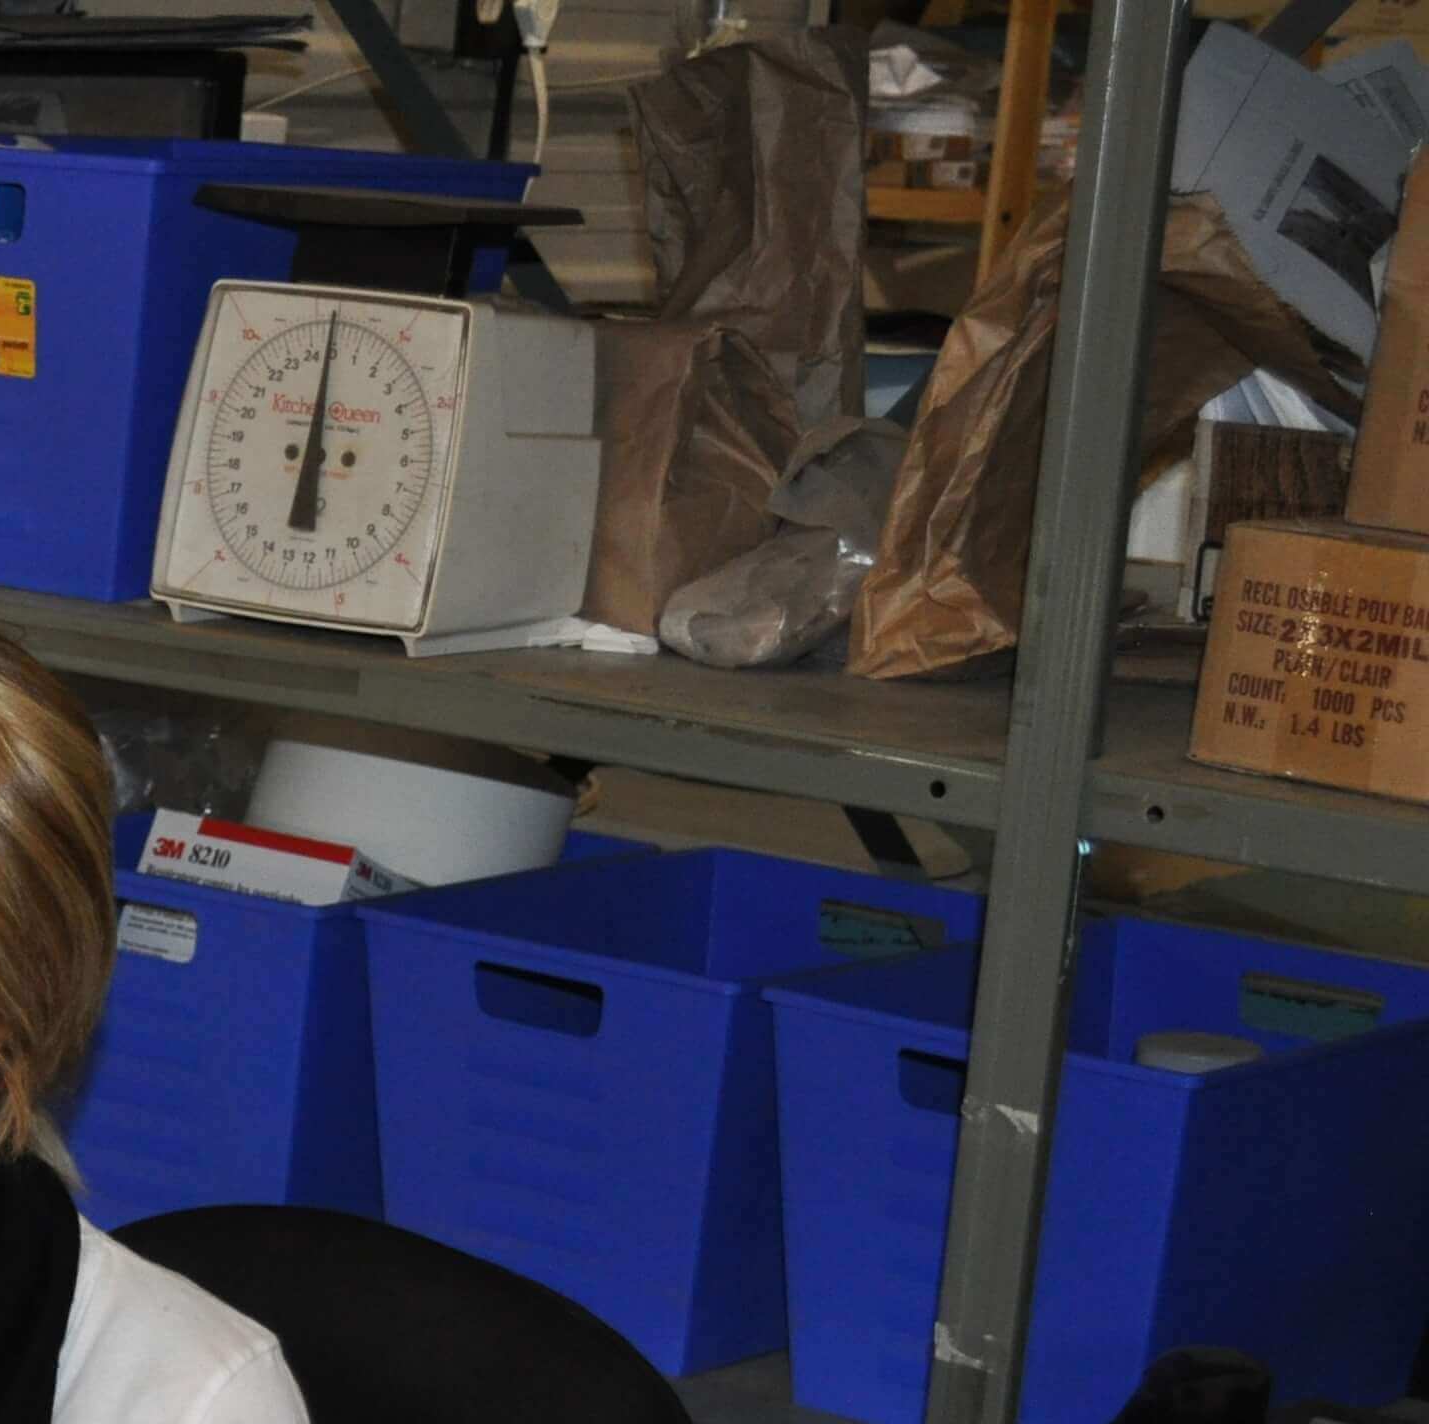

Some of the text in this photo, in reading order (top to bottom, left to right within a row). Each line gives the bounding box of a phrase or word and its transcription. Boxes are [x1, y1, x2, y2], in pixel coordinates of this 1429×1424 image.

[303, 350, 320, 362] 24
[284, 358, 300, 370] 23
[268, 369, 284, 382] 22
[241, 407, 255, 419] 20
[329, 402, 381, 424] Queen
[346, 537, 360, 549] 10
[303, 551, 316, 563] 12
[1356, 597, 1400, 626] POLY
[1313, 688, 1355, 715] 1000
[1369, 696, 1406, 724] PCS
[1290, 713, 1321, 737] 1.4
[1332, 720, 1366, 747] LBS
[153, 837, 231, 869] 3M 8210
